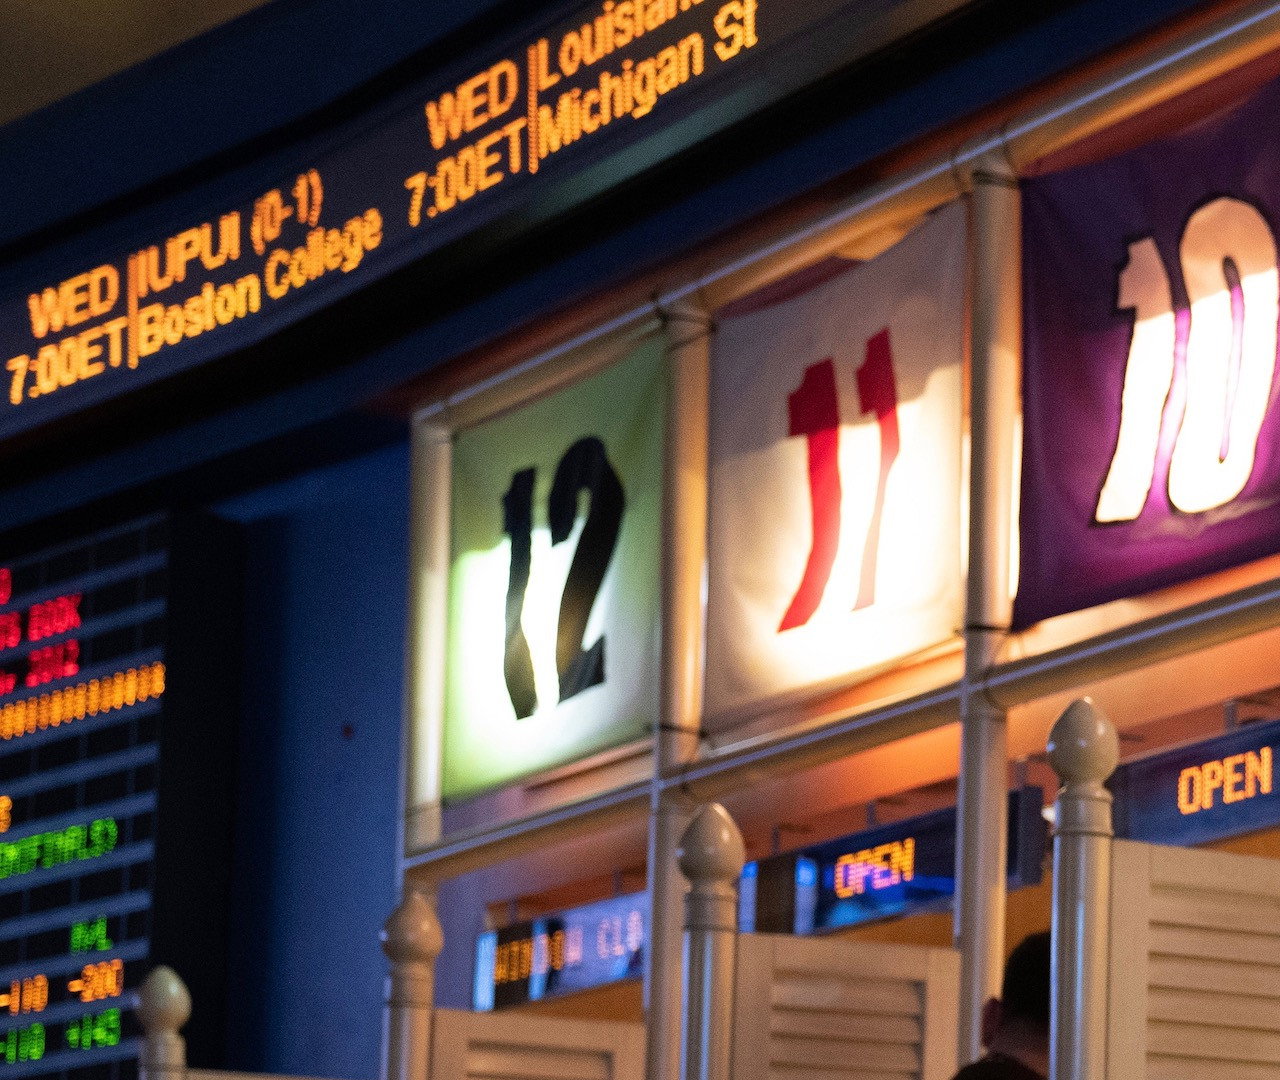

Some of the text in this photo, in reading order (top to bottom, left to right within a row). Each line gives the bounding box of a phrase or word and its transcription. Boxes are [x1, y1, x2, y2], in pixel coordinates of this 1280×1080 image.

[404, 0, 758, 228] 7:00ET Michigan St
[425, 60, 518, 149] WED
[6, 208, 383, 405] 7:00ET Boston College
[28, 169, 324, 338] WED IUPUI (0-1)
[1090, 197, 1280, 528] 10
[502, 437, 626, 721] 12
[777, 328, 899, 635] 11
[834, 837, 917, 900] OPEN
[1176, 746, 1274, 817] OPEN
